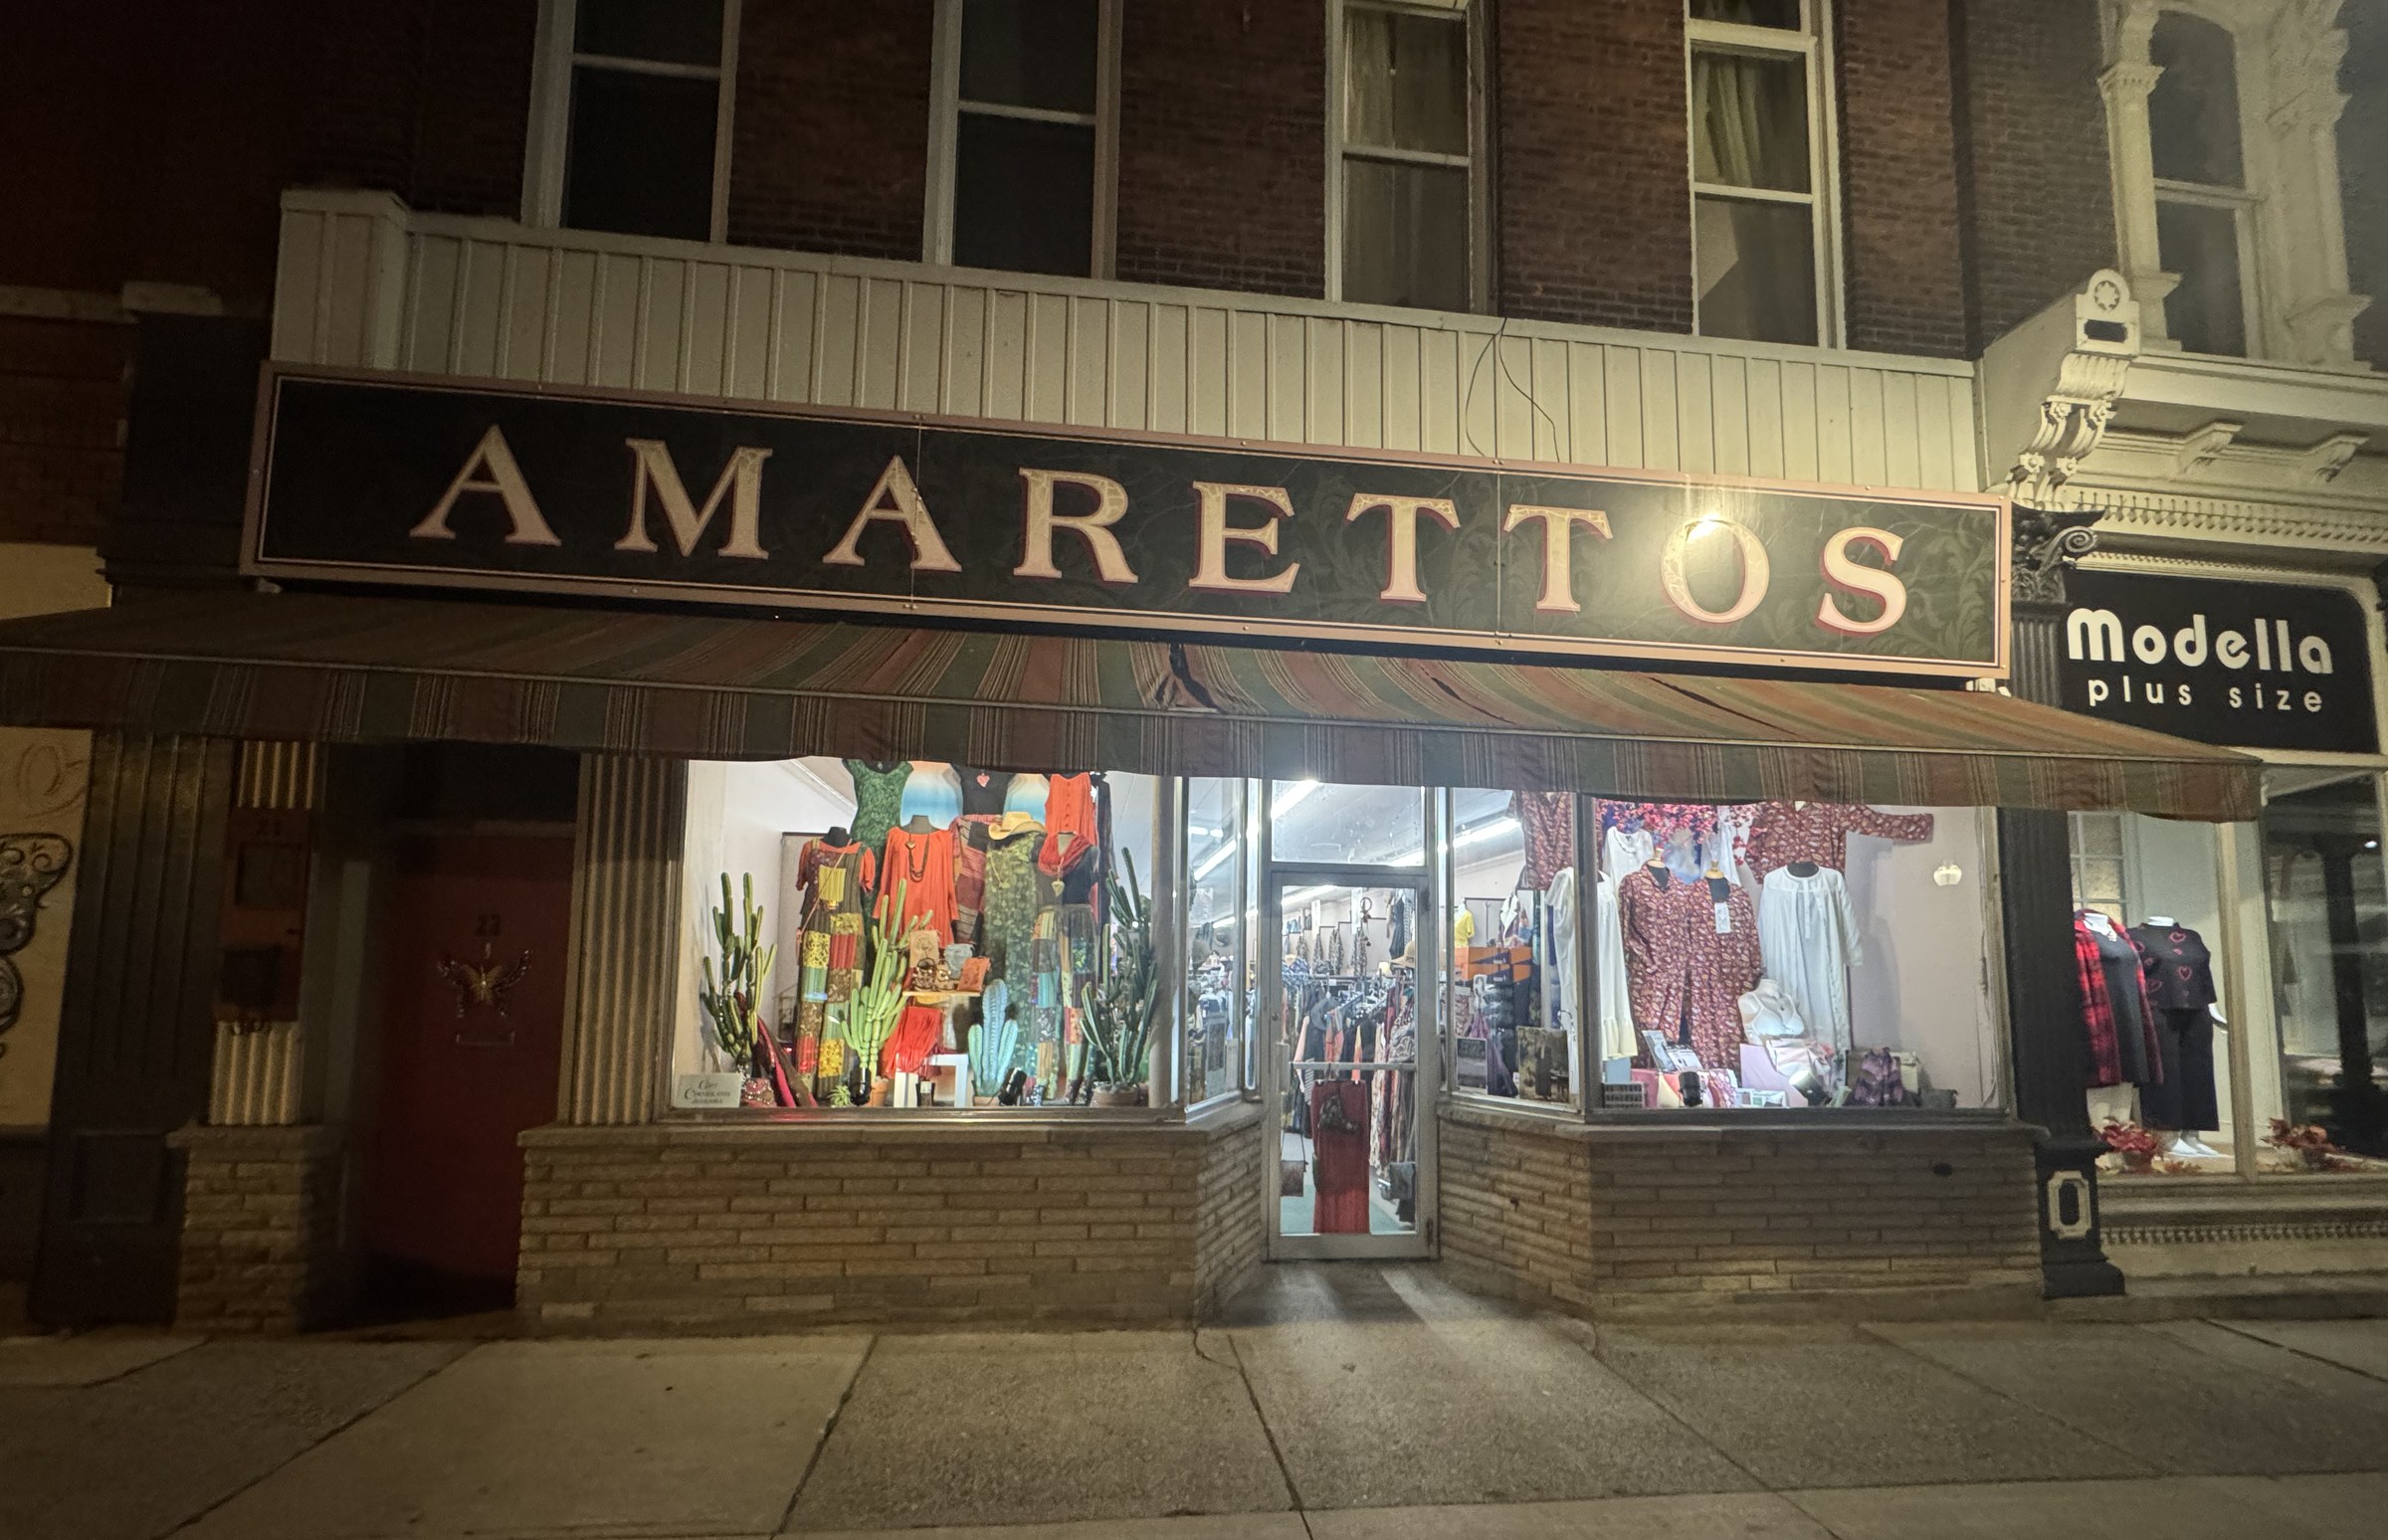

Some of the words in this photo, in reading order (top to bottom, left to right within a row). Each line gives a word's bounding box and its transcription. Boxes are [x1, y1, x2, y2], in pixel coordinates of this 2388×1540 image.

[409, 423, 1908, 635] AMARETTOS
[2067, 607, 2334, 674] Modella
[2088, 675, 2193, 707] plus
[2229, 682, 2323, 713] size
